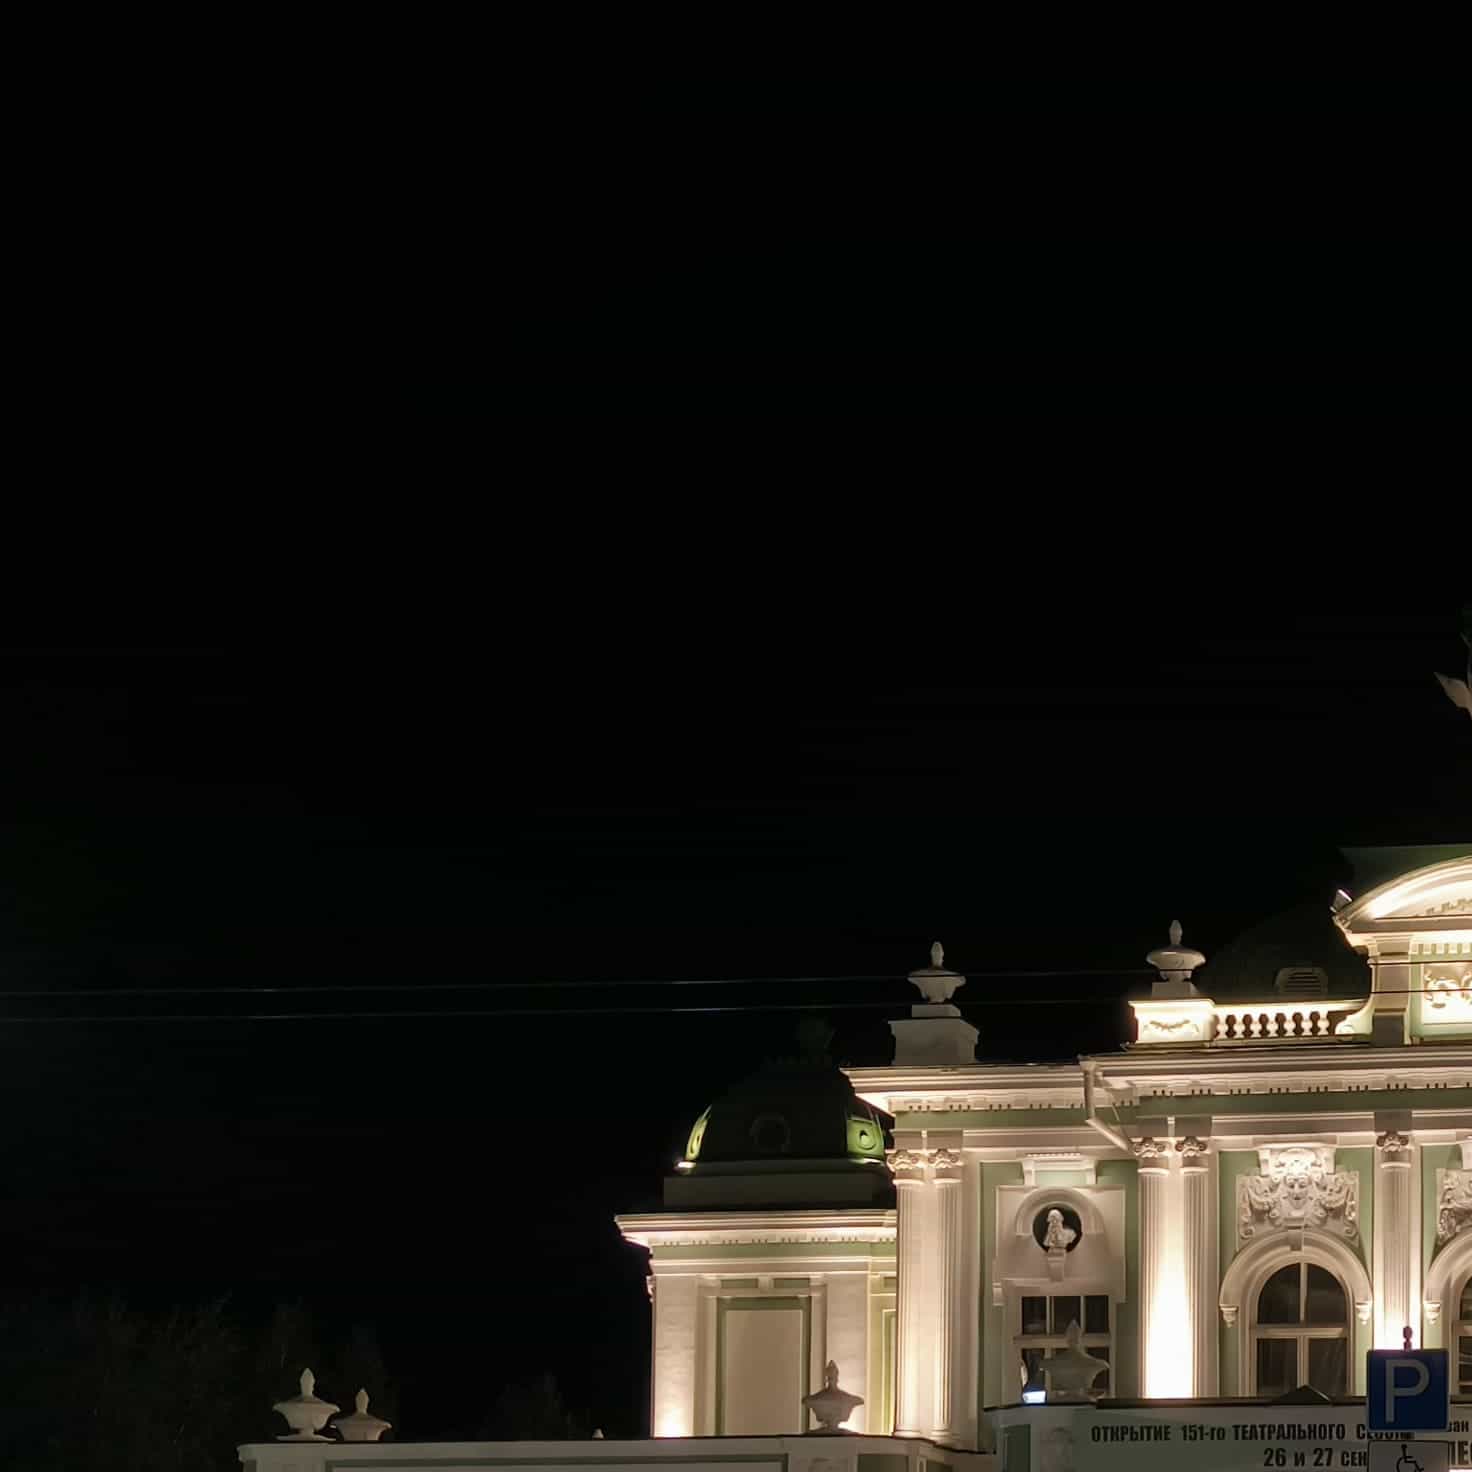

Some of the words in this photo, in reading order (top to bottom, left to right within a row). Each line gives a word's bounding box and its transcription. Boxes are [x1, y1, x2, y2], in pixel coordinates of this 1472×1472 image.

[1091, 1424, 1171, 1442] ОТКРЫТИЕ
[1181, 1424, 1226, 1441] 151-го
[1232, 1423, 1346, 1441] ТЕАТРАЛЬНОГО
[1263, 1448, 1287, 1467] 26
[1294, 1452, 1305, 1466] и
[1313, 1448, 1333, 1467] 27
